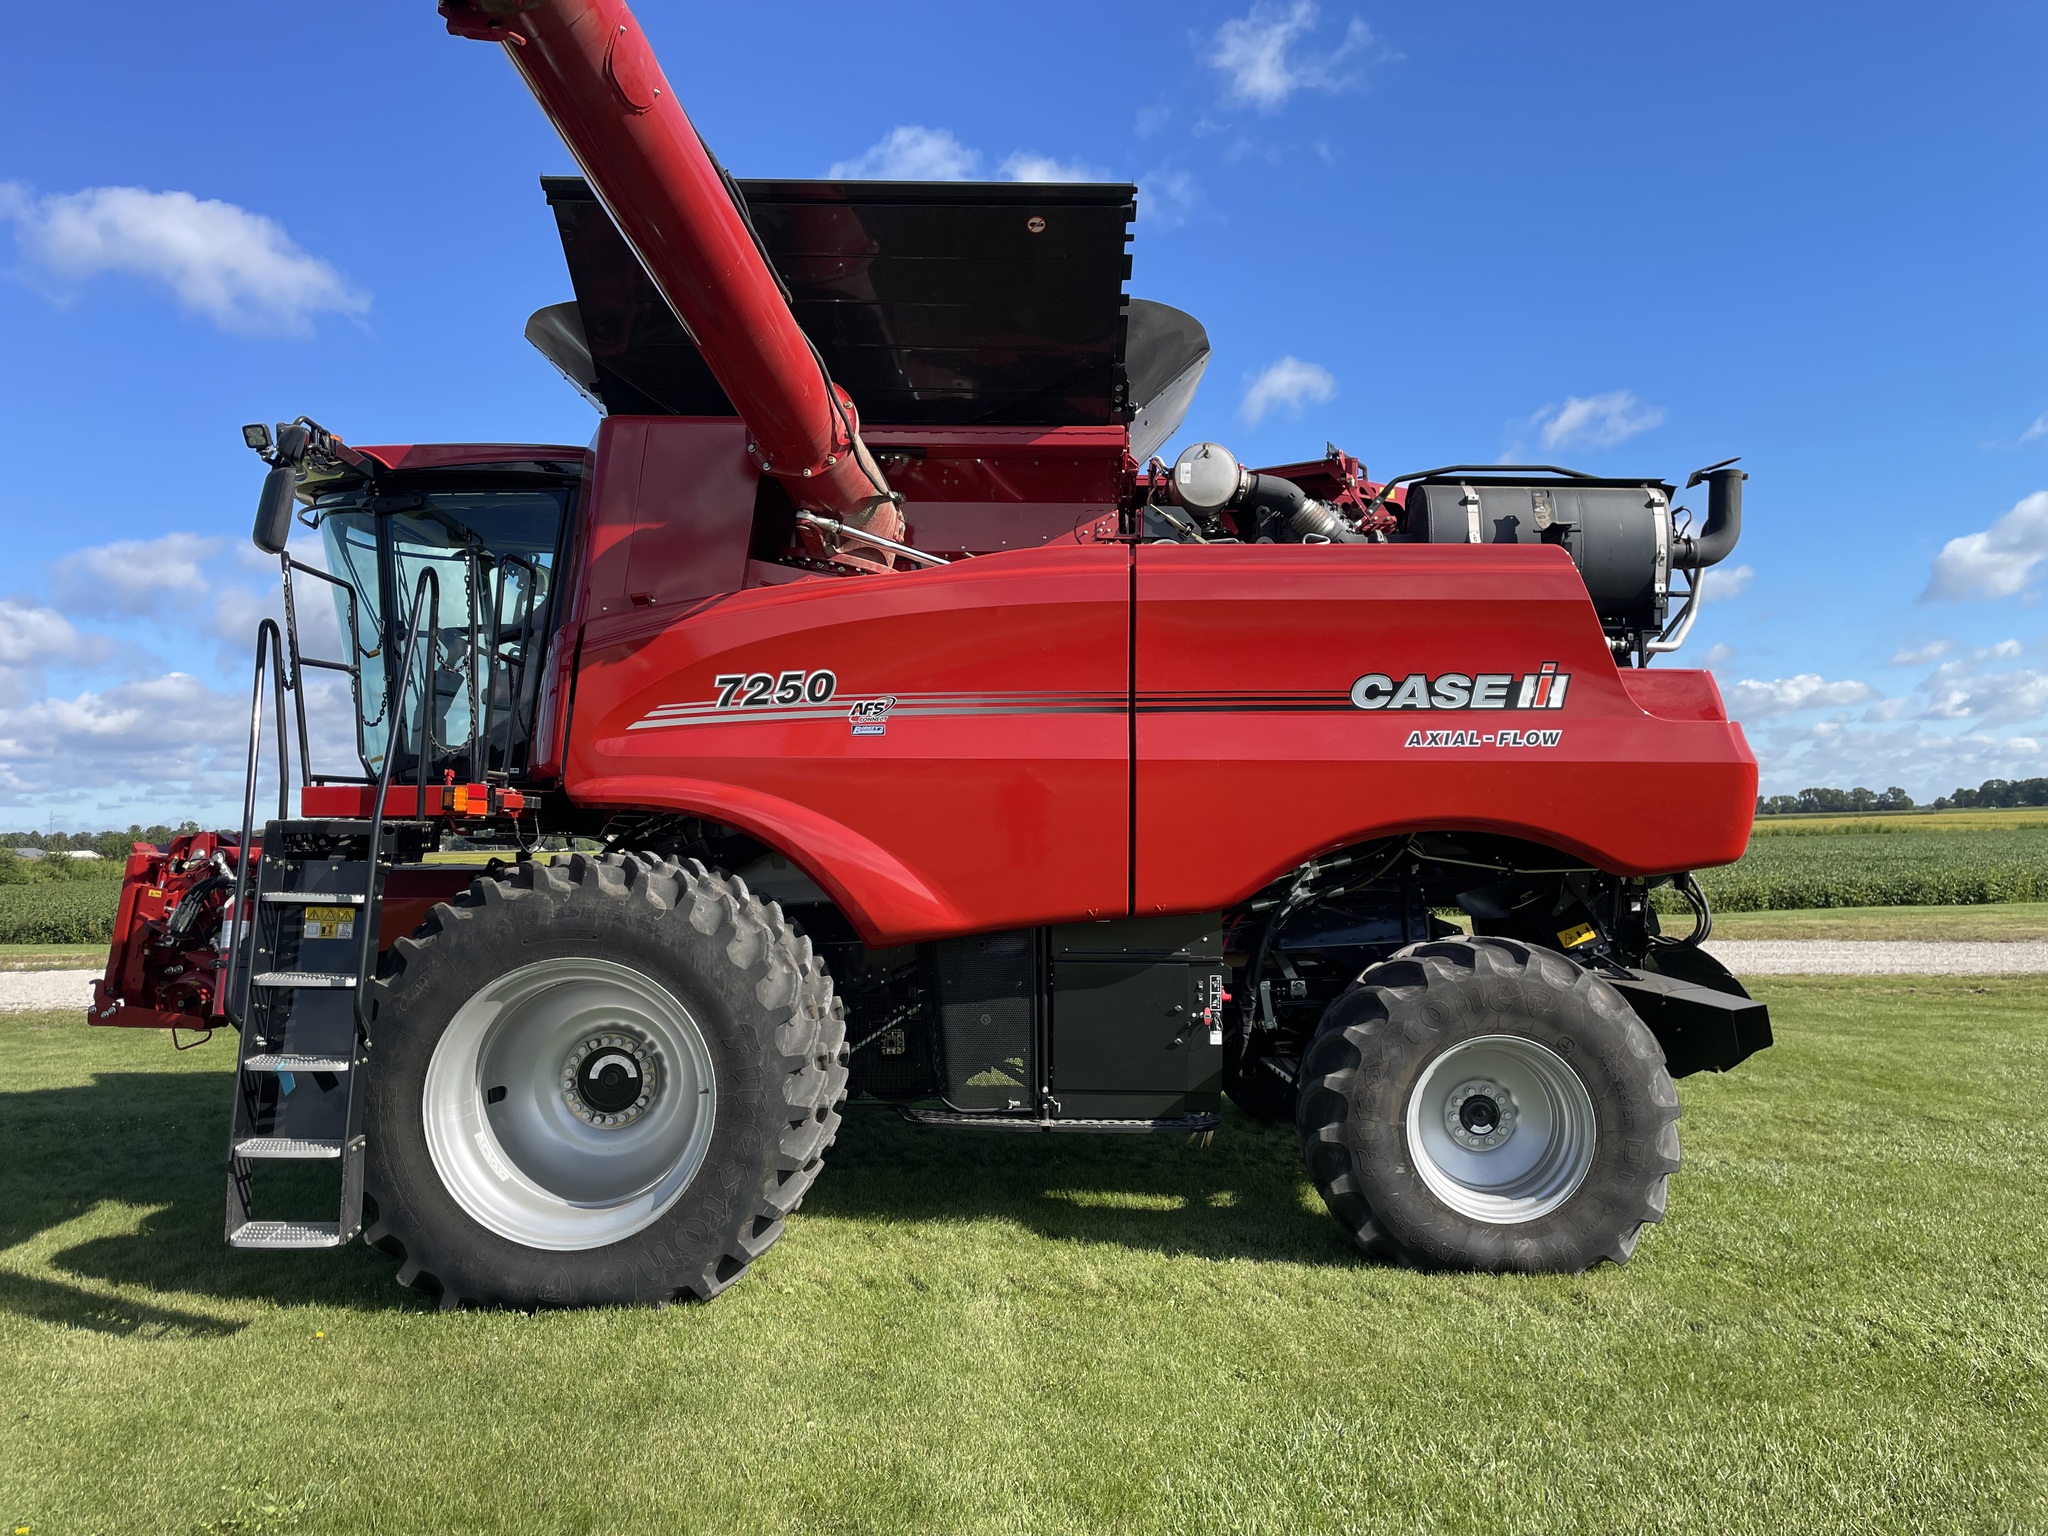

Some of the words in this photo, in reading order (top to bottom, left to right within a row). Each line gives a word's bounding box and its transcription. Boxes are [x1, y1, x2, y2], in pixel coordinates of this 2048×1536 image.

[714, 669, 837, 710] 7250
[1350, 673, 1512, 709] CASE
[849, 700, 887, 717] AFS
[1404, 730, 1562, 748] AXIAL-FLOW
